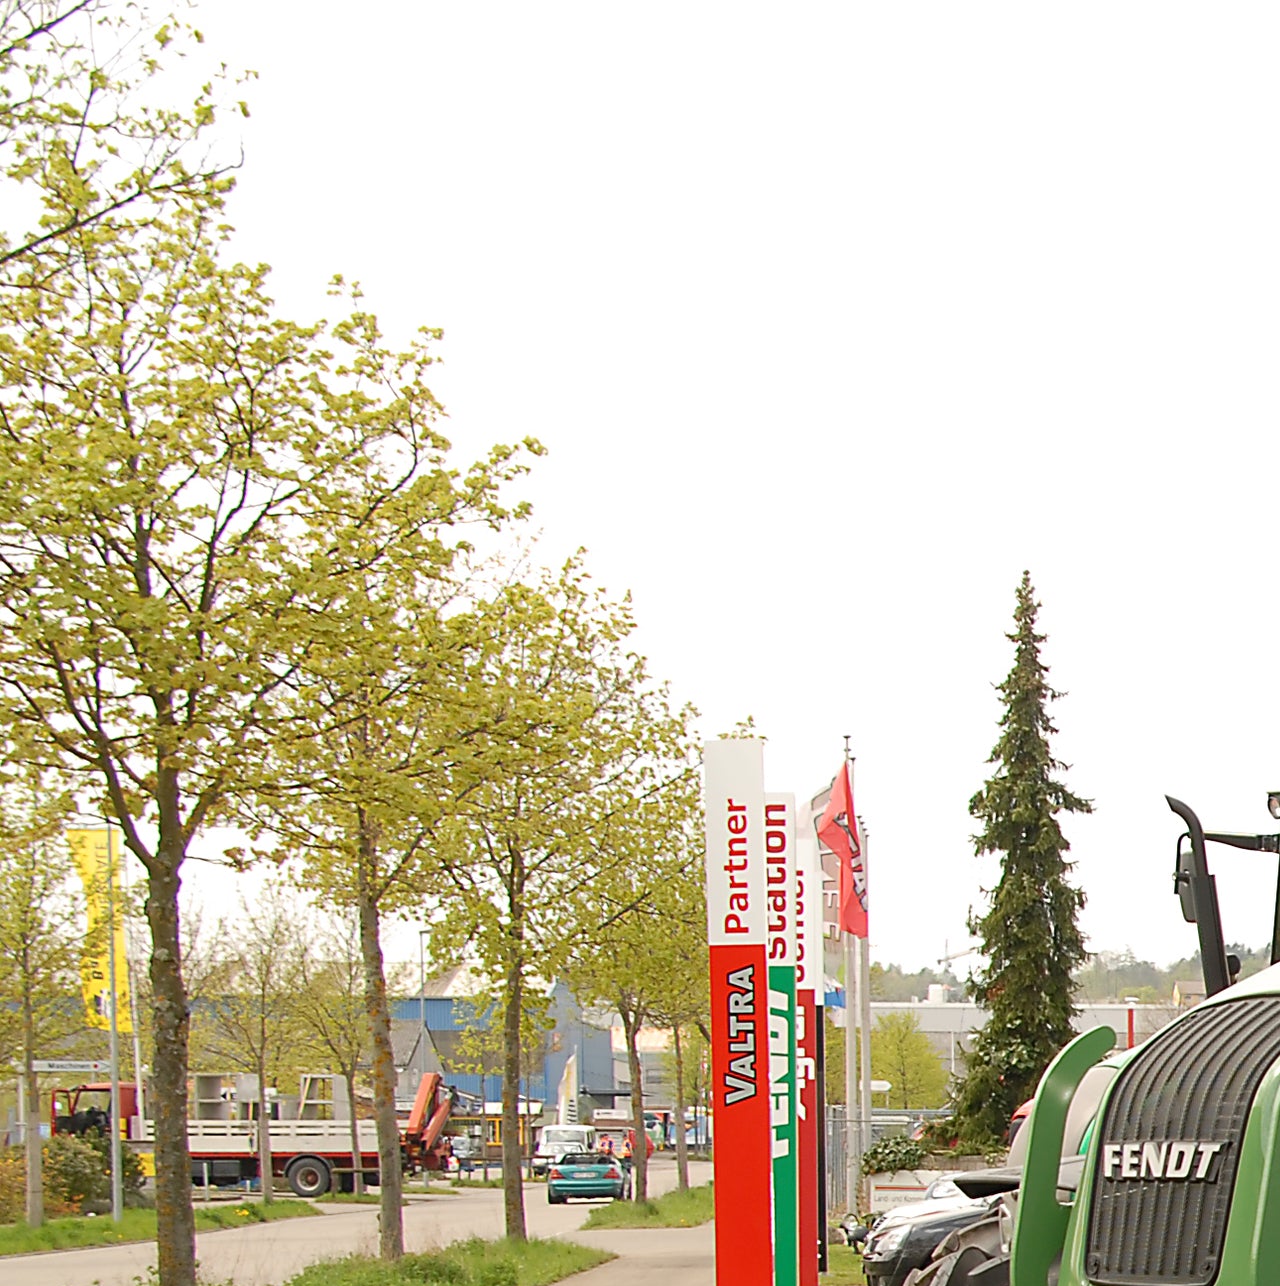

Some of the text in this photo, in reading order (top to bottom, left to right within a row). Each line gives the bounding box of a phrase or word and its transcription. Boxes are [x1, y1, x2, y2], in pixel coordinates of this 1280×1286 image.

[724, 798, 757, 1107] VALTRA Partner
[1103, 1141, 1222, 1180] FENDT
